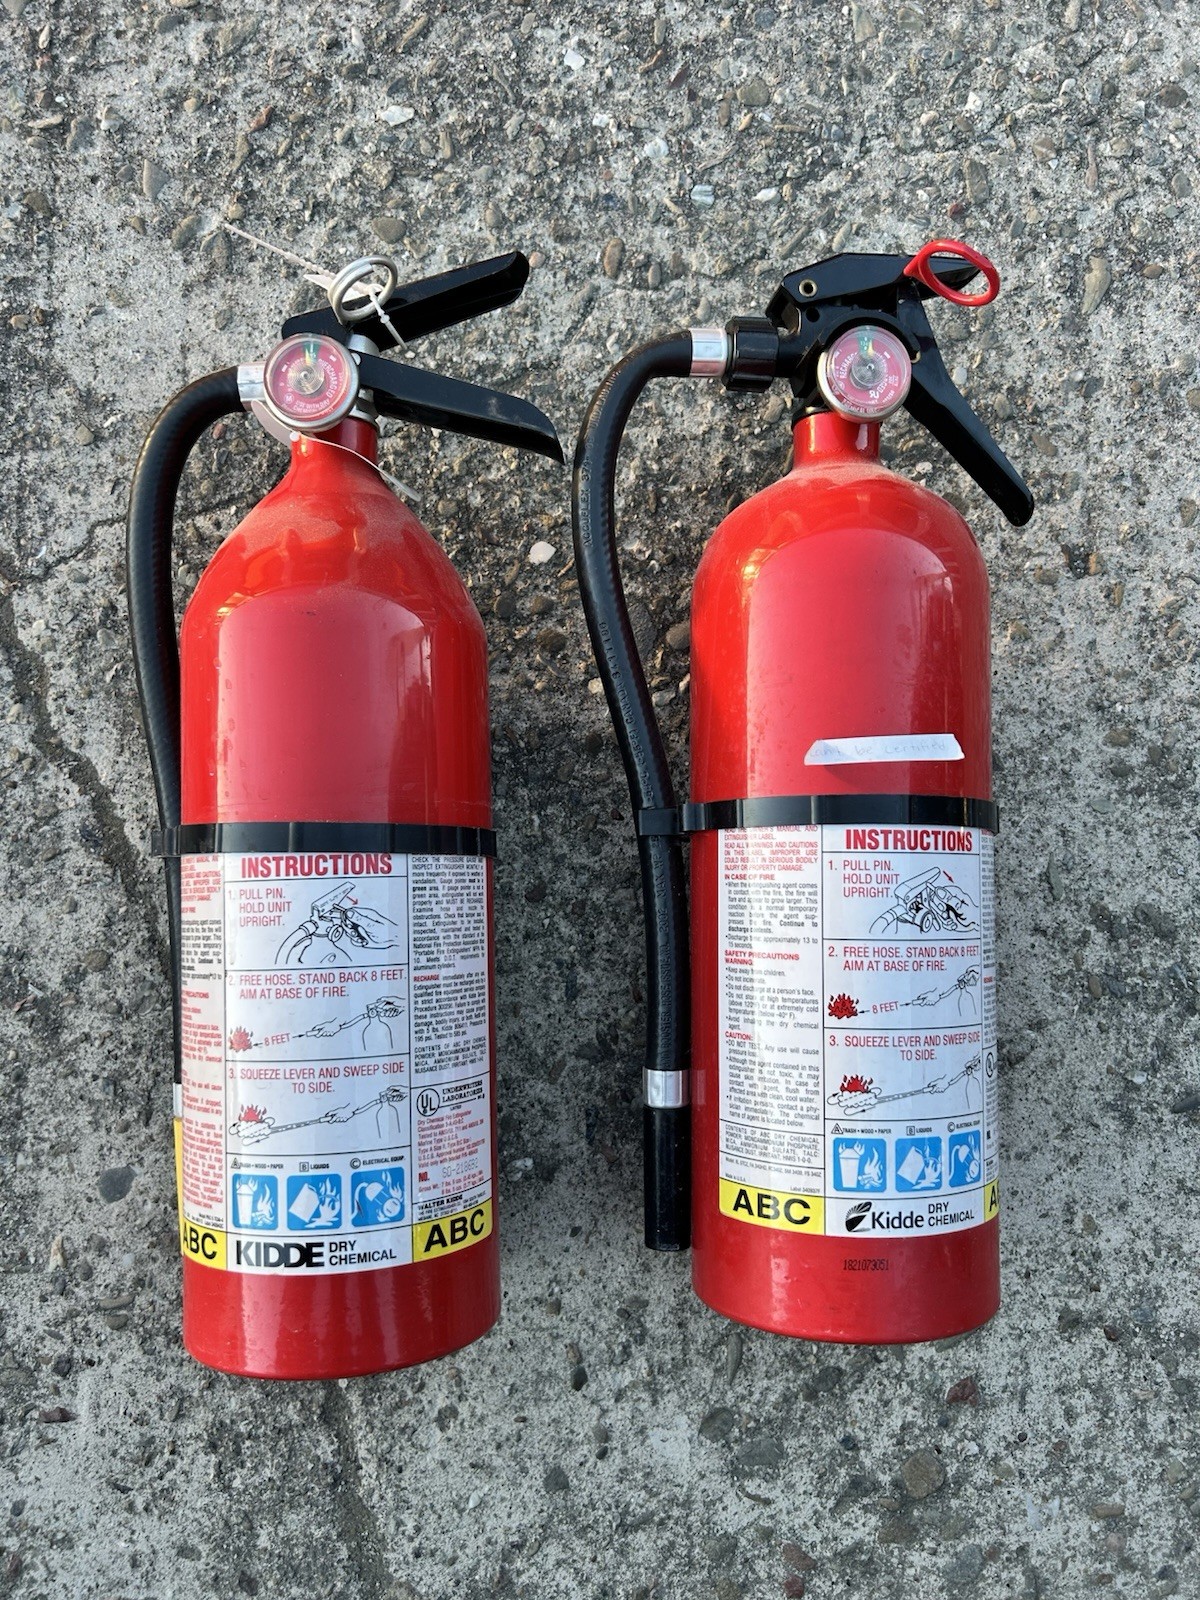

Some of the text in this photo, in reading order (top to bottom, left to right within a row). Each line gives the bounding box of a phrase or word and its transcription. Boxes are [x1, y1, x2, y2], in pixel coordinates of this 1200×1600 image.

[846, 829, 973, 851] INSTRUCTIONS
[241, 853, 393, 879] INSTRUCTIONS
[828, 860, 894, 871] 1. PULL PIN.
[843, 874, 900, 884] HOLD UNIT
[239, 888, 264, 900] PULL
[266, 887, 286, 900] PIN.
[843, 887, 894, 898] UPRIGHT.
[239, 901, 292, 914] HOLD UNIT
[239, 915, 286, 928] UPRIGHT.
[748, 951, 800, 960] PRECAUTIONS
[828, 947, 838, 957] 2.
[844, 947, 868, 958] FREE
[872, 946, 902, 958] HOSE.
[906, 946, 937, 958] STAND
[938, 946, 960, 957] BACK
[960, 946, 966, 956] 8
[843, 960, 947, 971] AIM AT BASE OF FIRE.
[239, 974, 262, 986] FREE
[264, 973, 296, 985] HOSE.
[299, 971, 336, 984] STAND
[339, 970, 368, 983] BACK
[371, 970, 378, 981] 8
[380, 969, 407, 981] FEET.
[239, 985, 350, 1000] AIM AT BASE OF FIRE.
[872, 1001, 899, 1014] 8 FEET
[264, 1034, 290, 1046] 8 FEET
[830, 1031, 980, 1048] 3. SQUEEZE LEVER AND SWEEP SIDE
[900, 1049, 937, 1060] TO SIDE.
[228, 1061, 404, 1080] 3. SQUEEZE LEVER AND SWEEP SIDE
[292, 1081, 335, 1093] TO SIDE.
[418, 1200, 444, 1210] WALTER
[732, 1188, 811, 1225] ABC
[929, 1202, 949, 1214] DRY
[871, 1211, 924, 1229] Kidde
[928, 1210, 975, 1227] CHEMICAL
[424, 1208, 484, 1253] ABC
[183, 1222, 217, 1260] ABC
[329, 1240, 357, 1253] DRY
[236, 1240, 324, 1268] KIDDE
[329, 1250, 397, 1266] CHEMICAL
